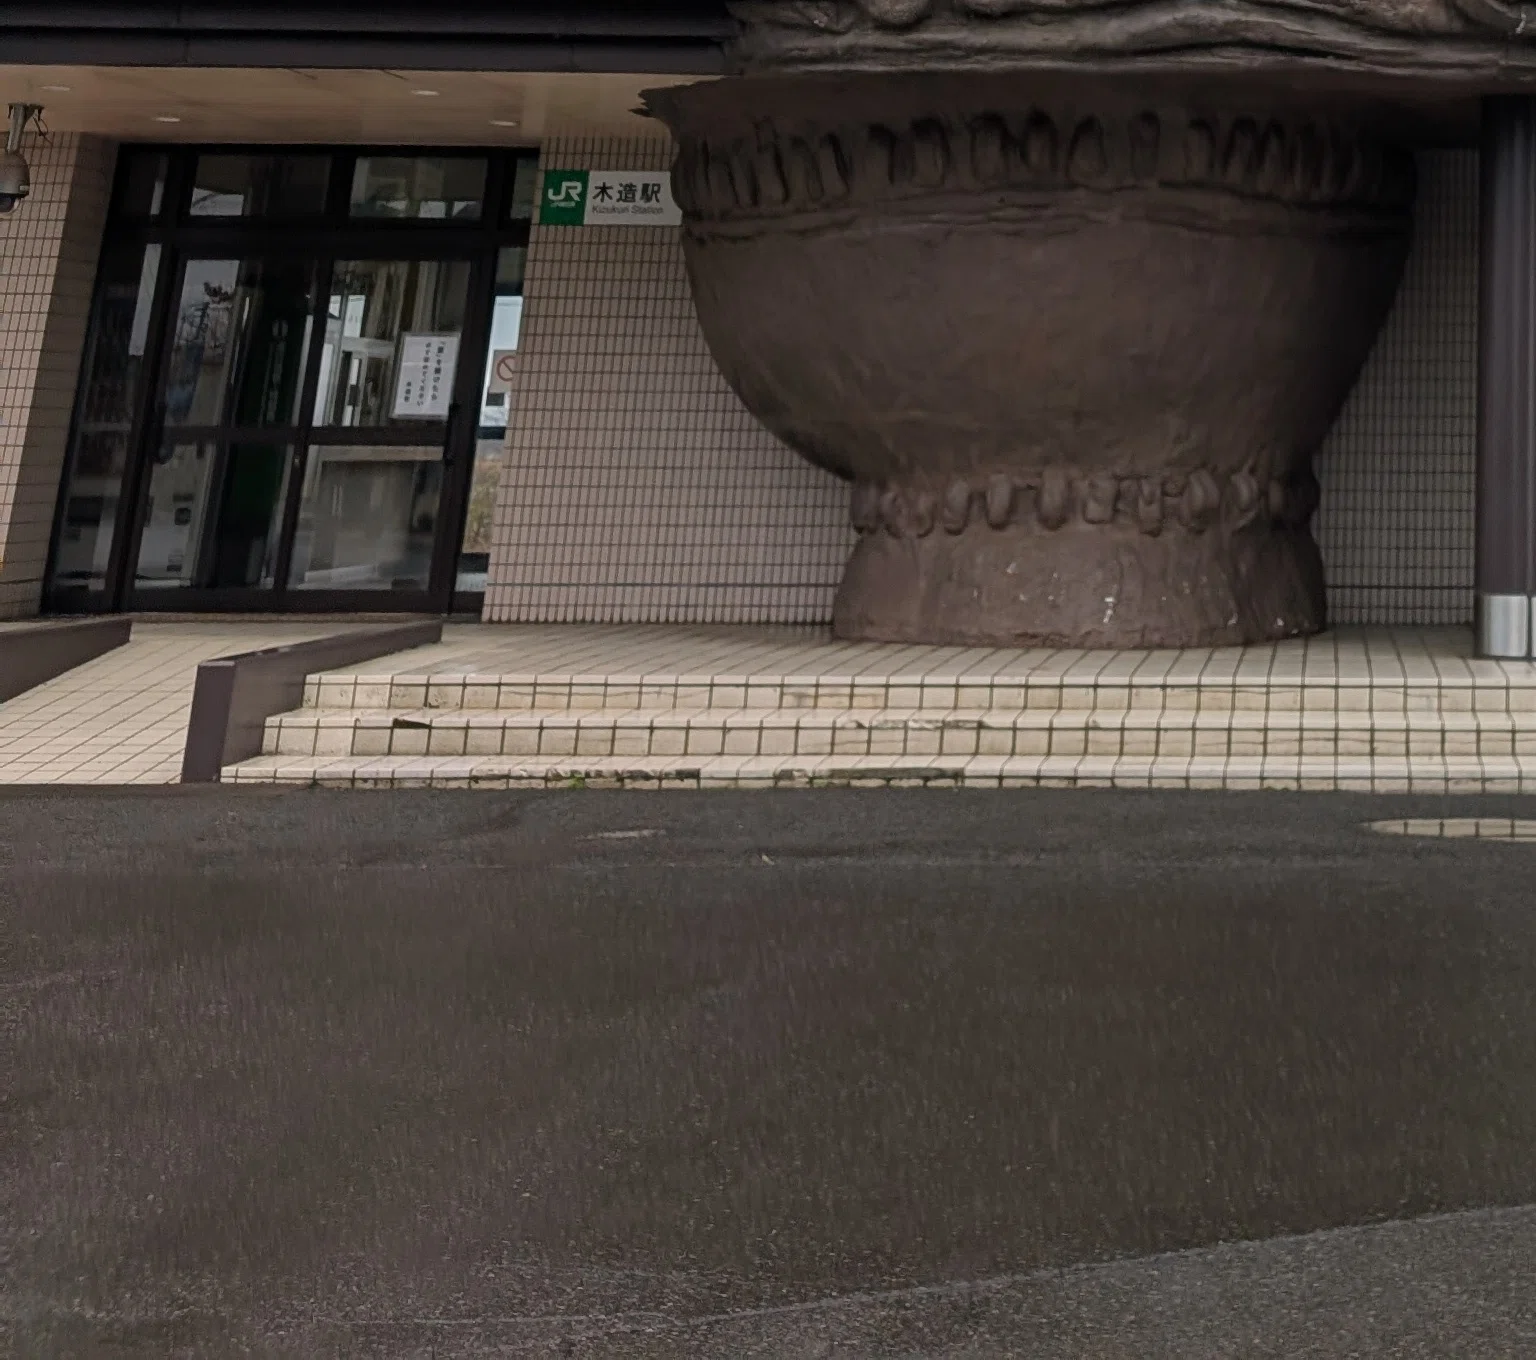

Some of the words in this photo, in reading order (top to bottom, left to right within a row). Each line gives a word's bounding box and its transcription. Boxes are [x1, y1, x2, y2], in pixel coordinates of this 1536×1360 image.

[547, 181, 583, 202] JR
[592, 181, 662, 203] 木造駅
